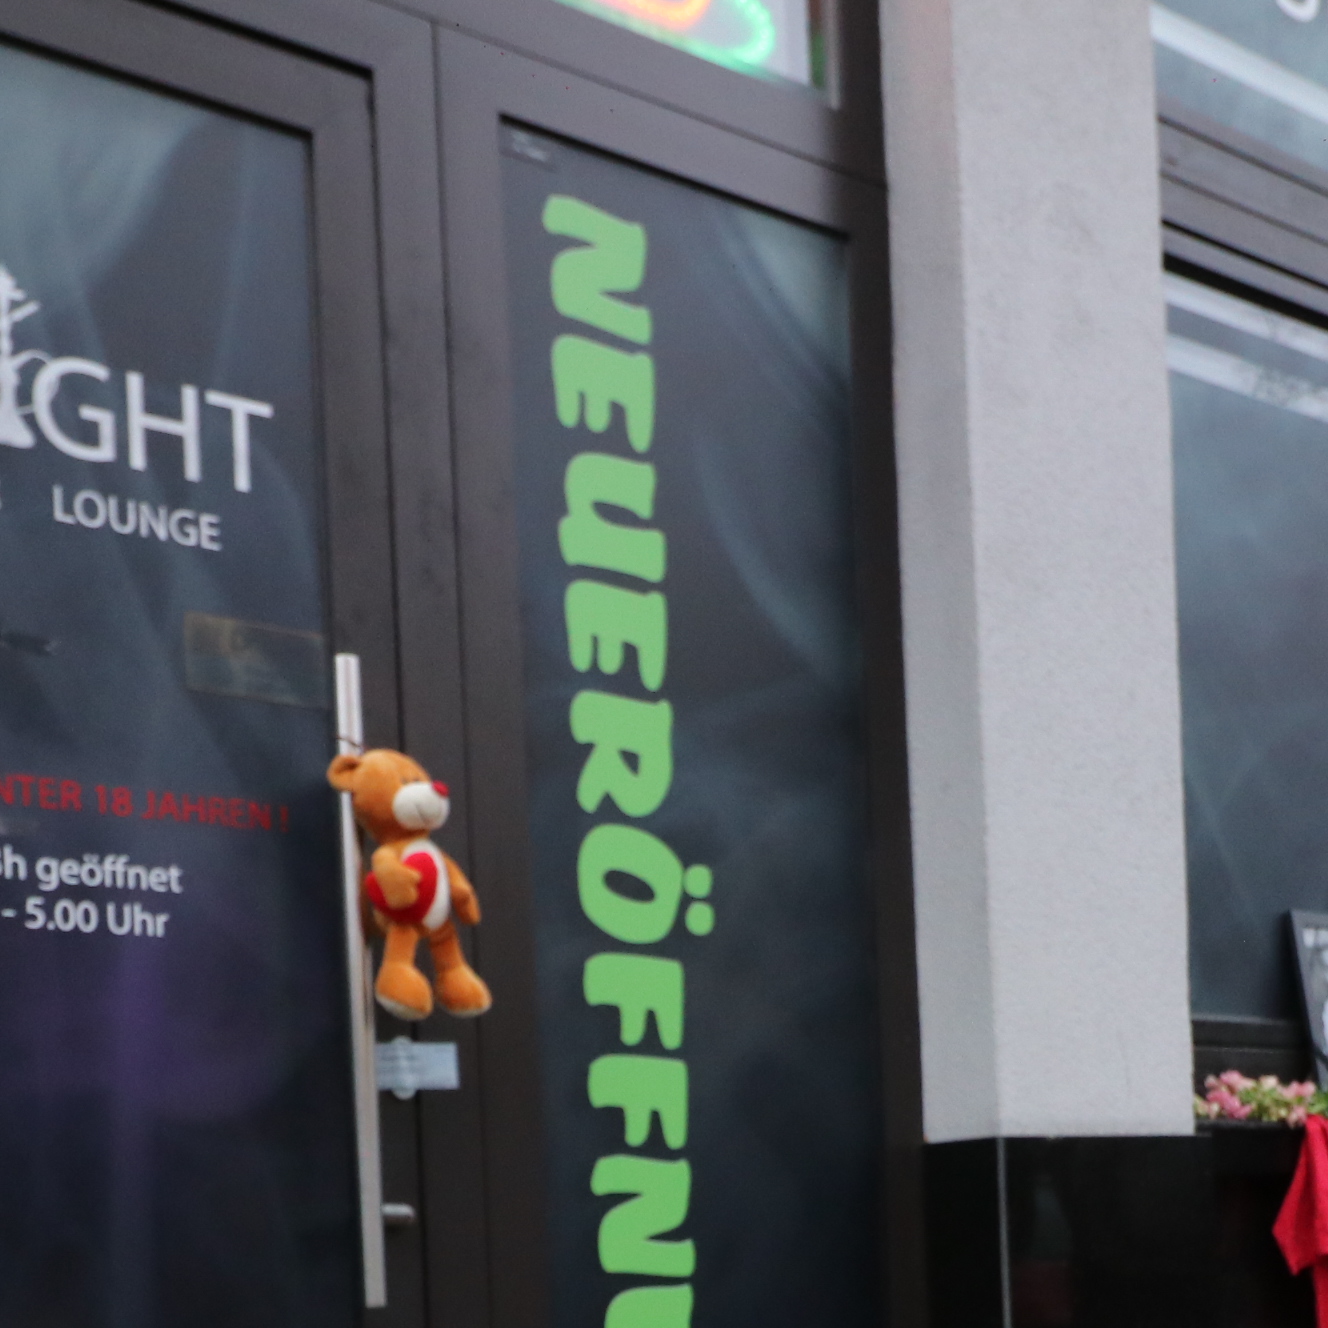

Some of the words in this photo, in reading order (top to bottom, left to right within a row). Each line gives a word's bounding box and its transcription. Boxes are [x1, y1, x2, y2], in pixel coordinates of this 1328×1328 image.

[52, 485, 223, 552] LOUNGE
[96, 784, 134, 819] 18
[141, 790, 272, 831] JAHREN
[35, 853, 183, 893] geöffnet
[24, 896, 99, 932] 5.00
[106, 901, 169, 938] Uhr
